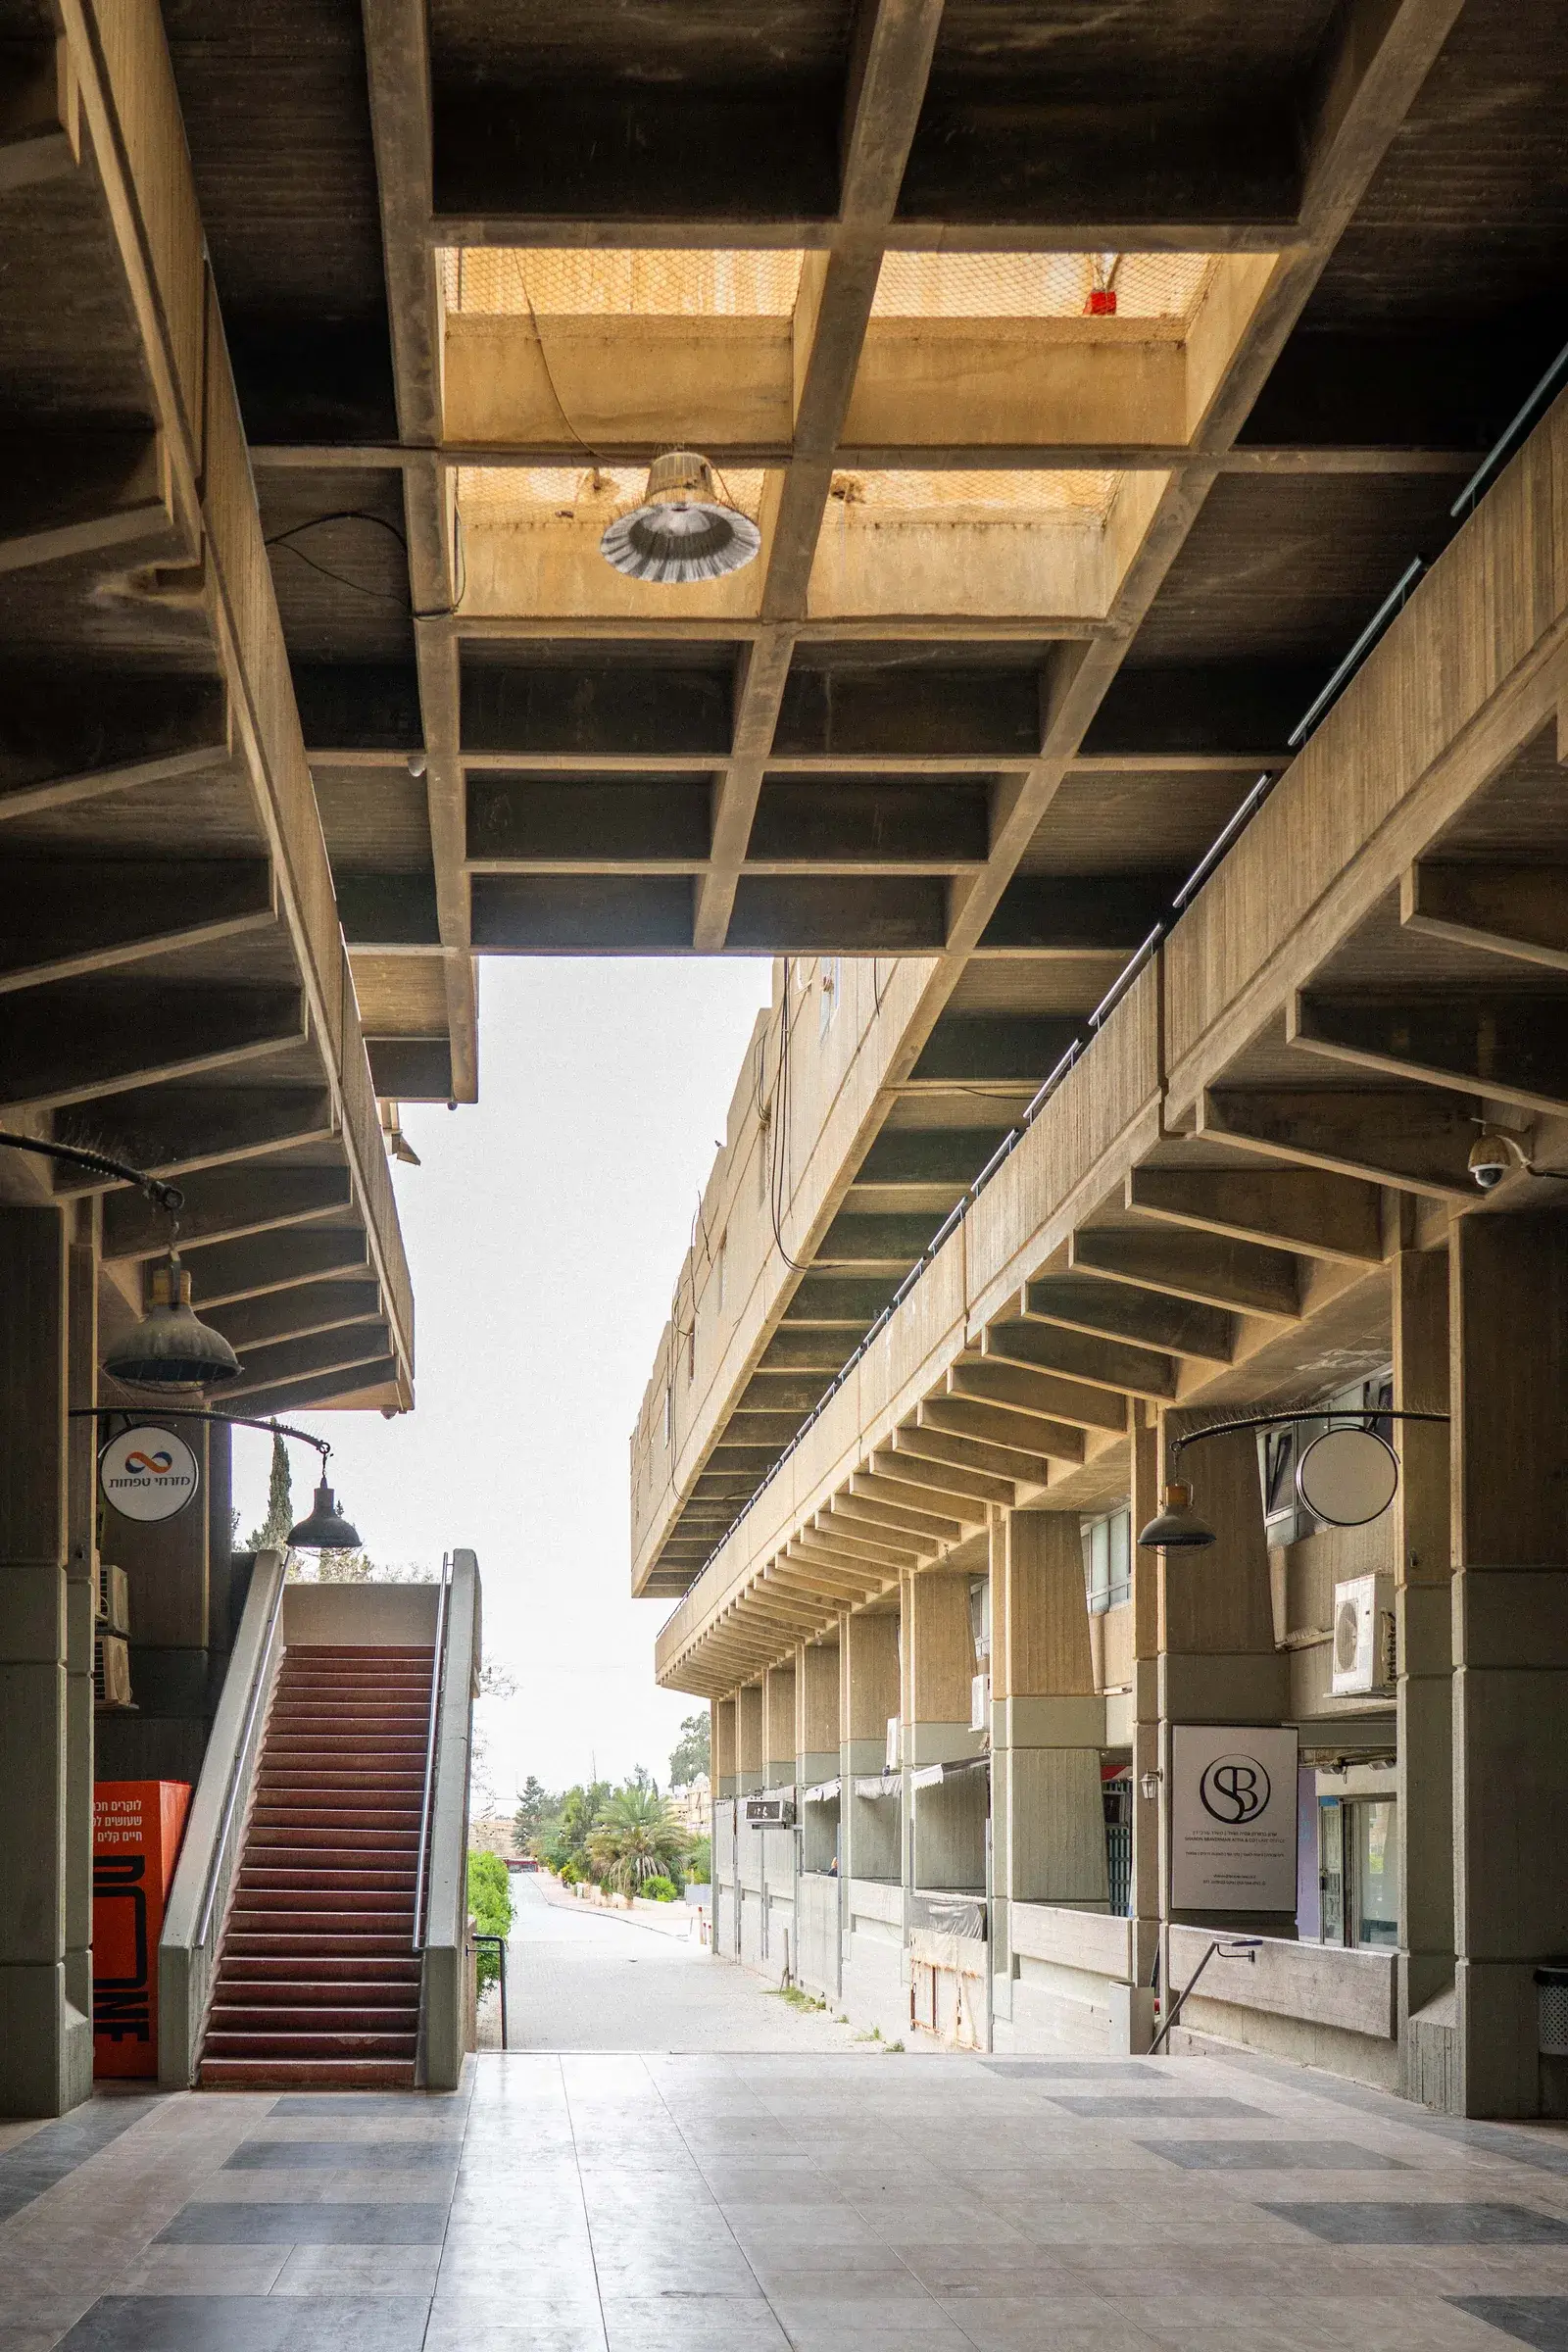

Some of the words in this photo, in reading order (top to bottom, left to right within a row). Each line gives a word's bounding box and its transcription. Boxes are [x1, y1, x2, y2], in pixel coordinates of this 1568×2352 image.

[109, 1477, 150, 1488] טפחות
[154, 1476, 190, 1486] מזרחי
[111, 1799, 142, 1812] לוקרים
[105, 1816, 142, 1826] שעושים
[97, 1831, 120, 1842] קלים
[122, 1831, 142, 1841] חיים
